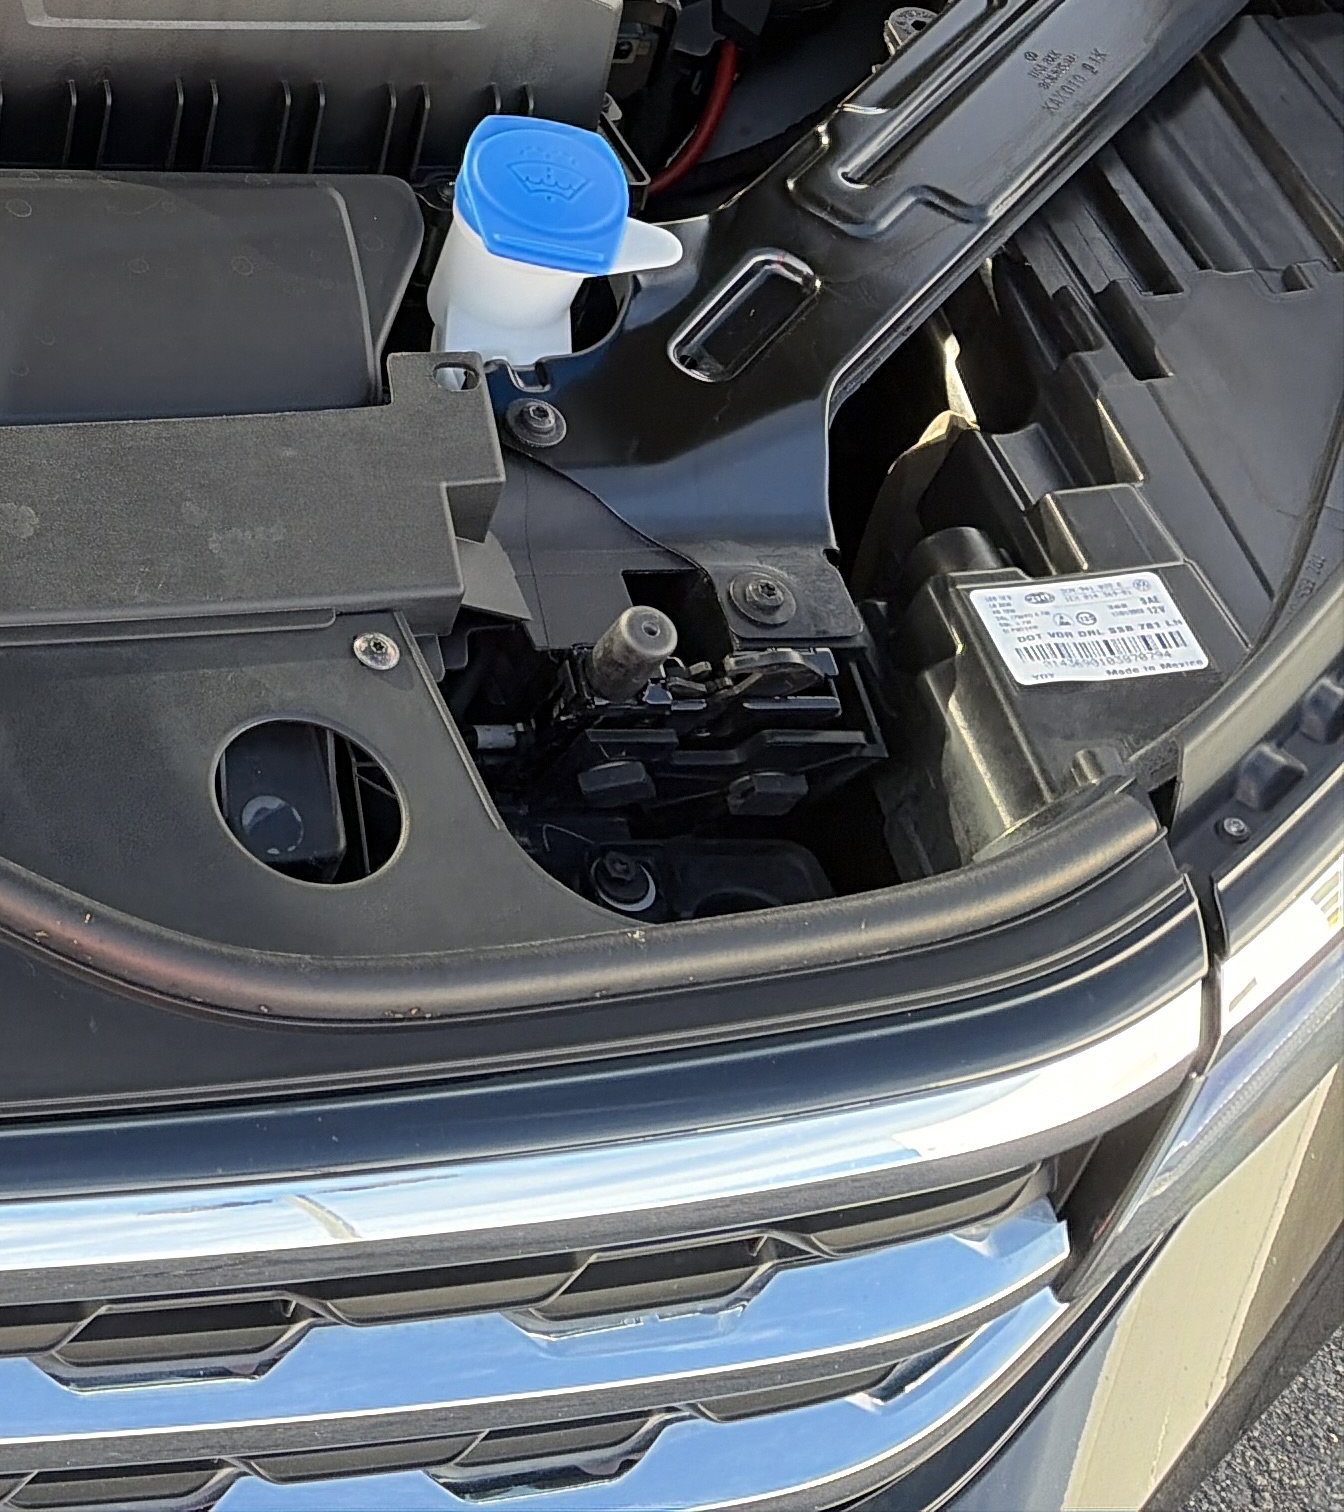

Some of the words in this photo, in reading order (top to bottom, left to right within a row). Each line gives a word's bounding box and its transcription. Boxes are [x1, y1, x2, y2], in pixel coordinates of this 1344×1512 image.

[1147, 605, 1166, 614] 12V
[1017, 633, 1042, 643] DOT
[1159, 659, 1204, 669] Mexico
